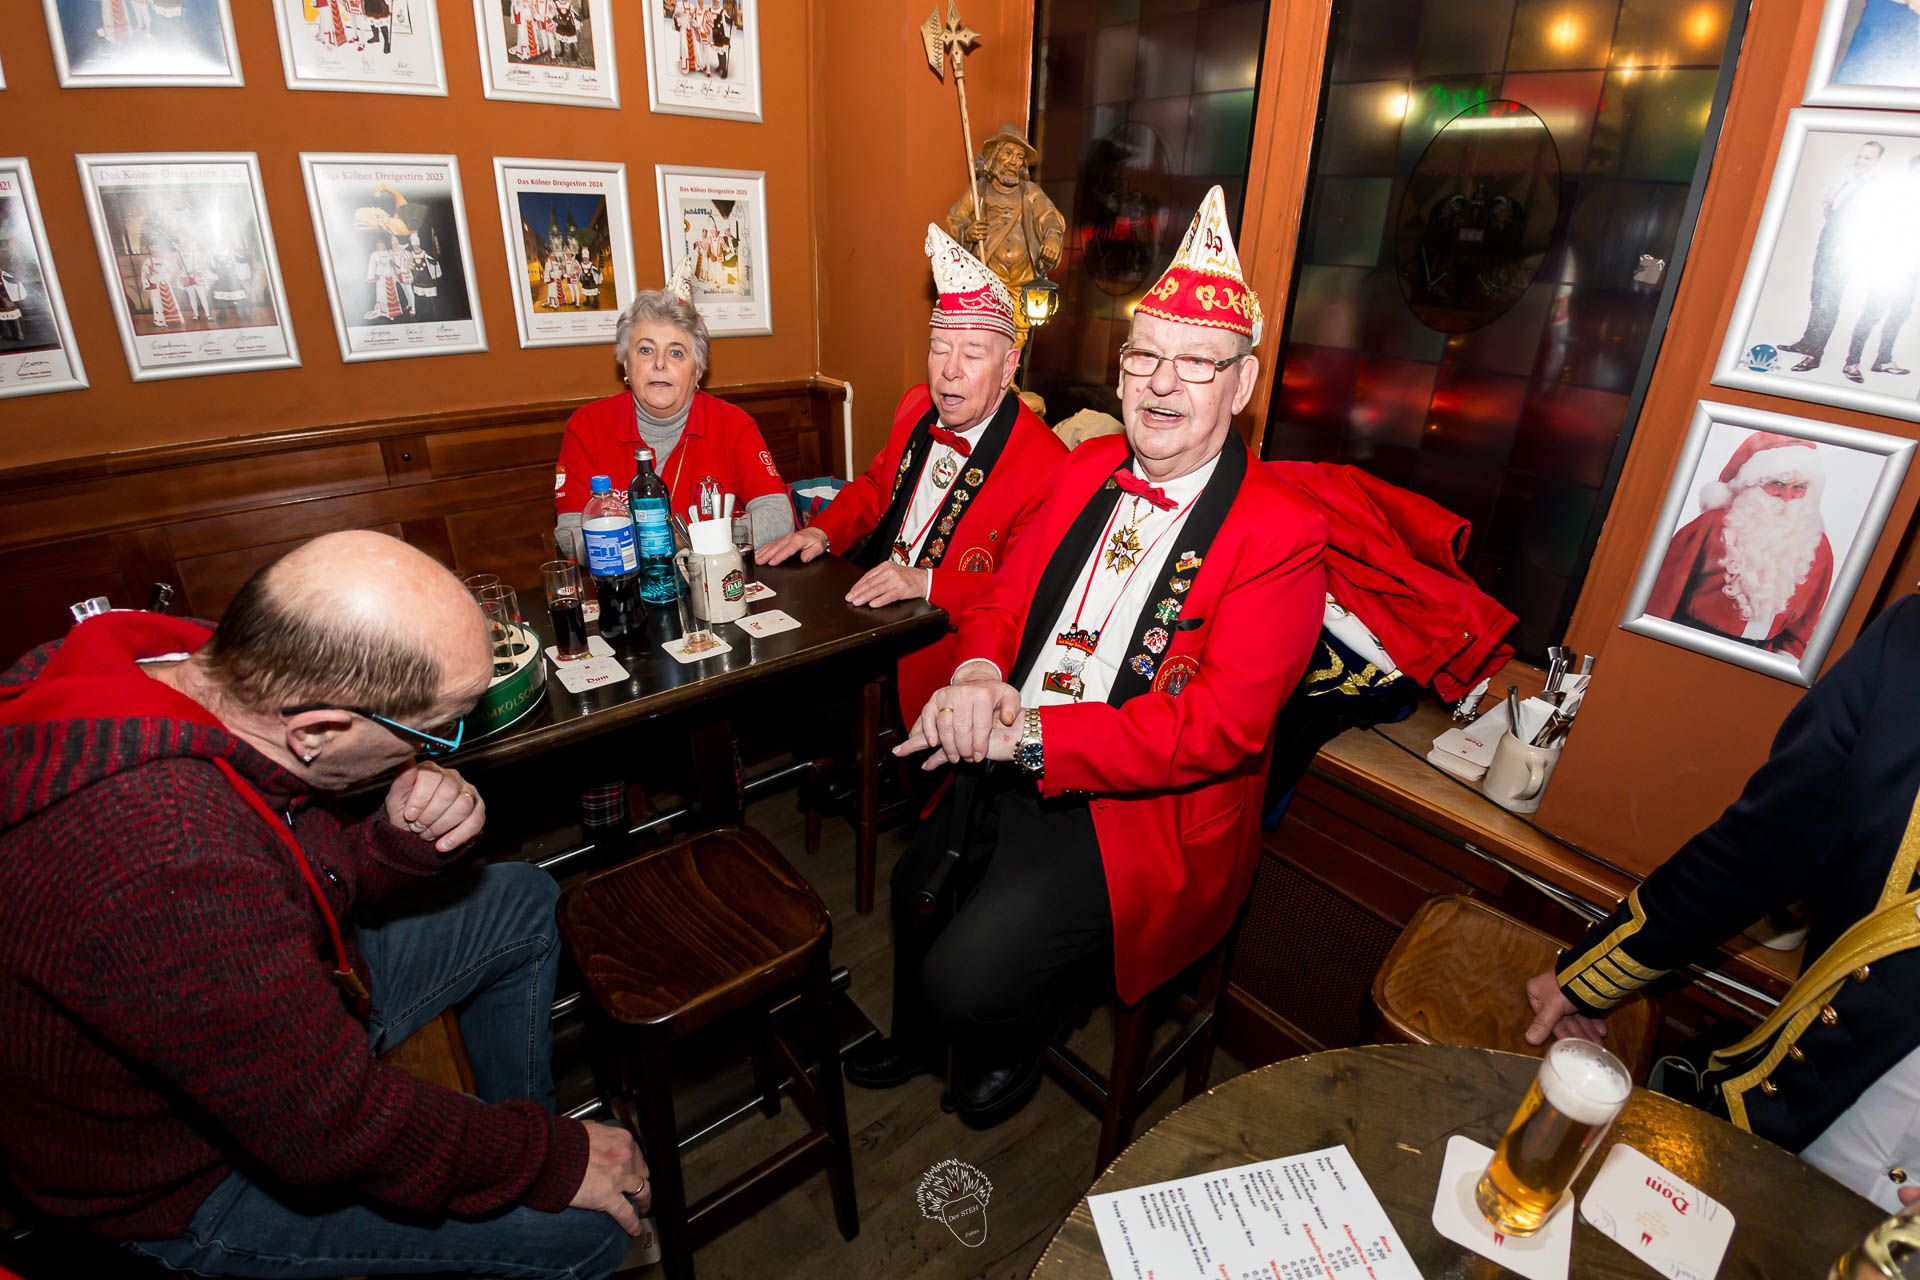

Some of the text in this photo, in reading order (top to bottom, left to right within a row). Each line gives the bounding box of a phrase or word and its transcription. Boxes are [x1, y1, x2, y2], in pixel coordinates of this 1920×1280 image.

[342, 171, 372, 180] Kölner
[375, 171, 423, 182] Dreigestirn
[426, 172, 444, 181] 2023
[0, 181, 11, 190] 21
[531, 178, 551, 186] Kölner
[552, 179, 587, 188] Dreigestirn
[586, 675, 609, 684] Dom
[1325, 1157, 1334, 1170] Dom
[1645, 1176, 1691, 1216] Dom
